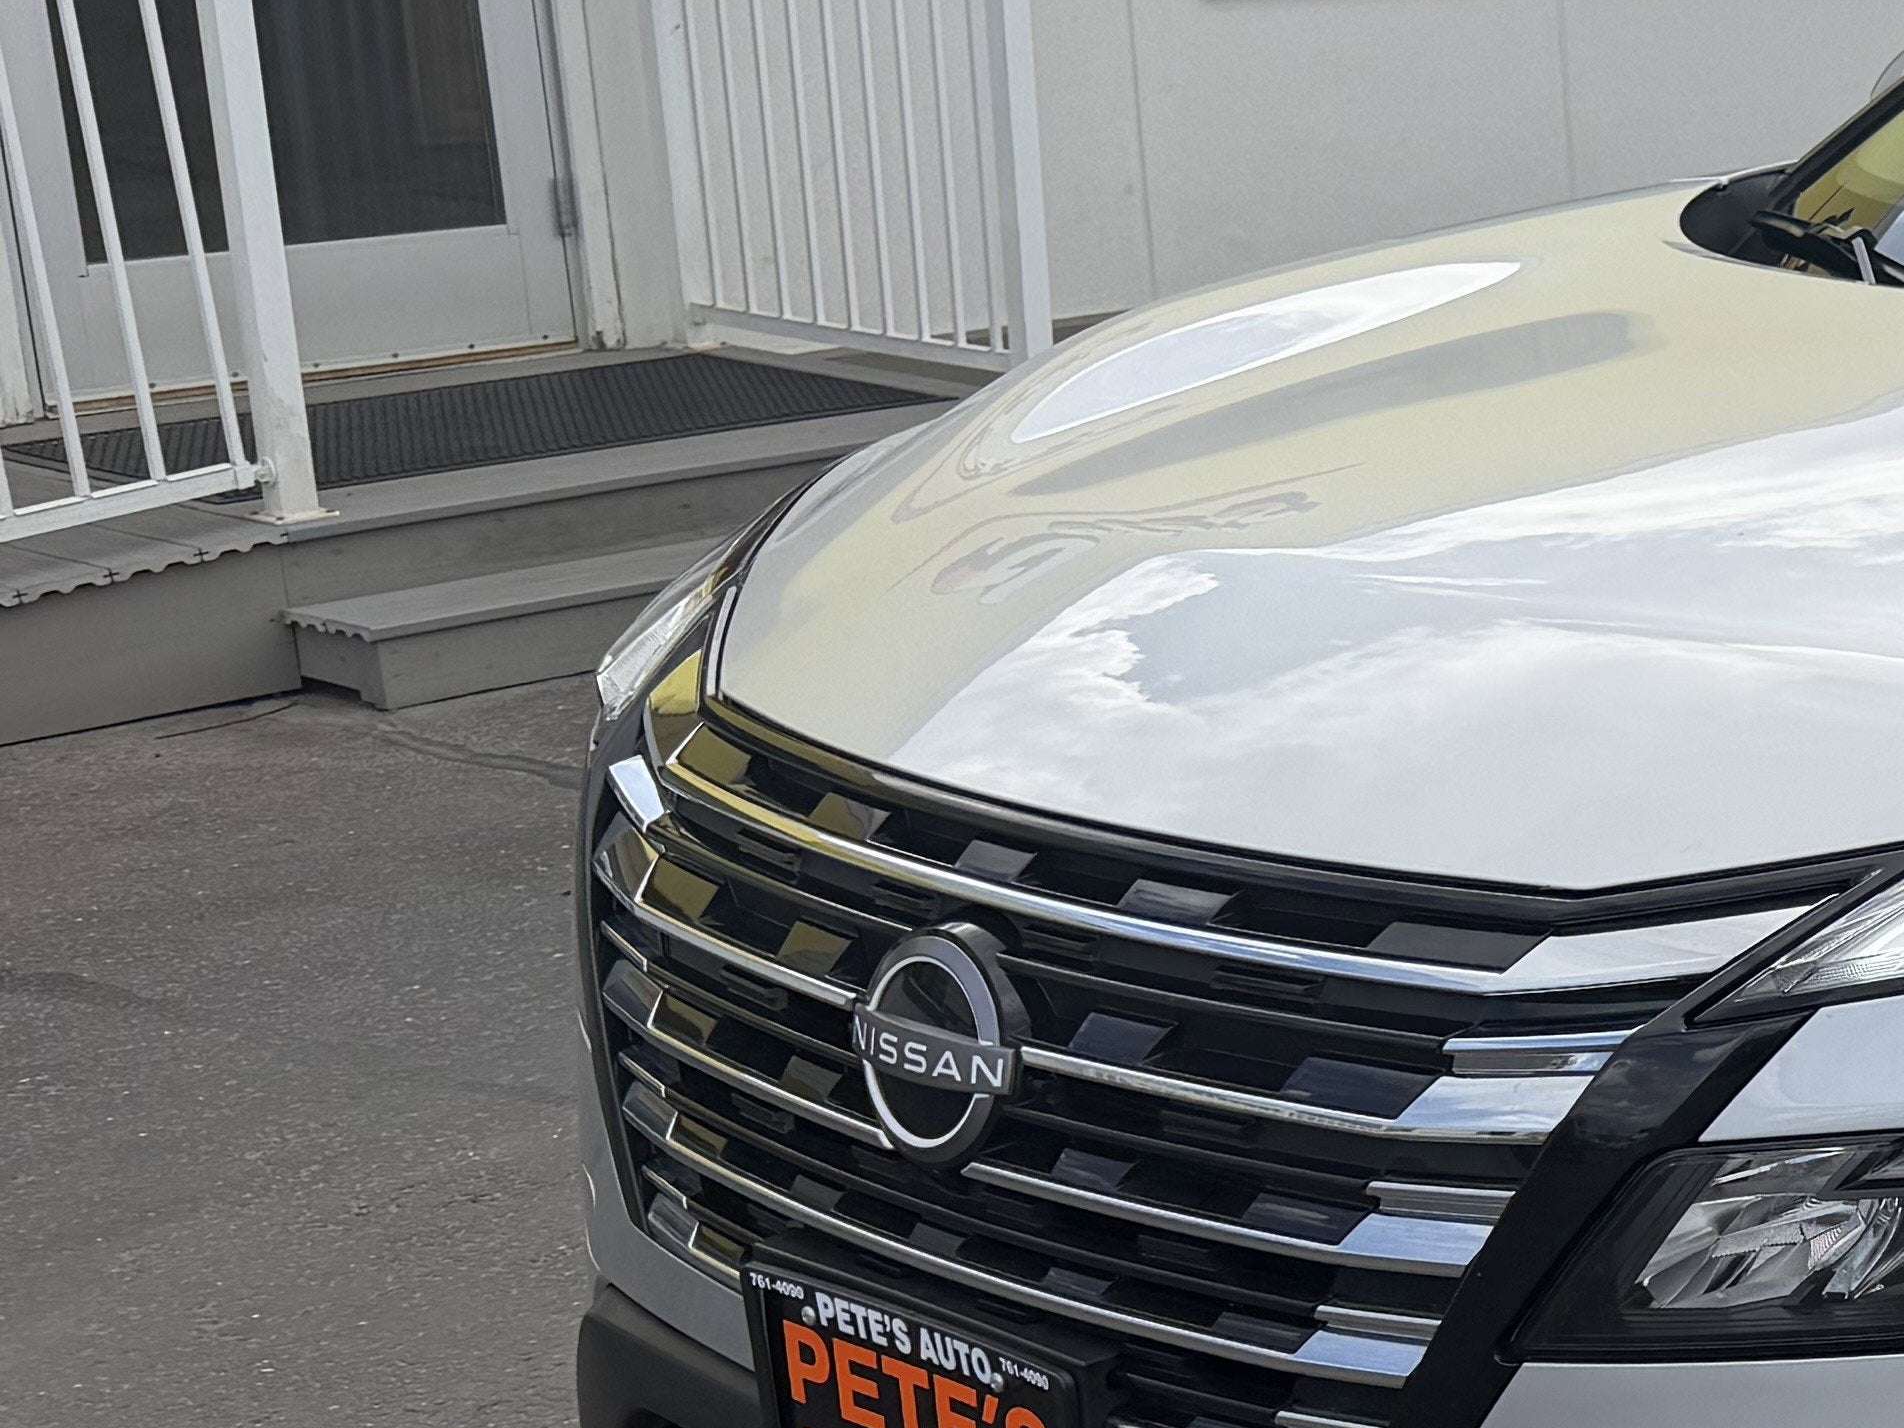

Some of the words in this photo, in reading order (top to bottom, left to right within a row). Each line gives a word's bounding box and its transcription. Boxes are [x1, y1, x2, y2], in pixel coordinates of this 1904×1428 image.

[852, 1015, 1004, 1088] NISSAN
[814, 1291, 912, 1355] PETE'S
[919, 1327, 992, 1385] AUTO
